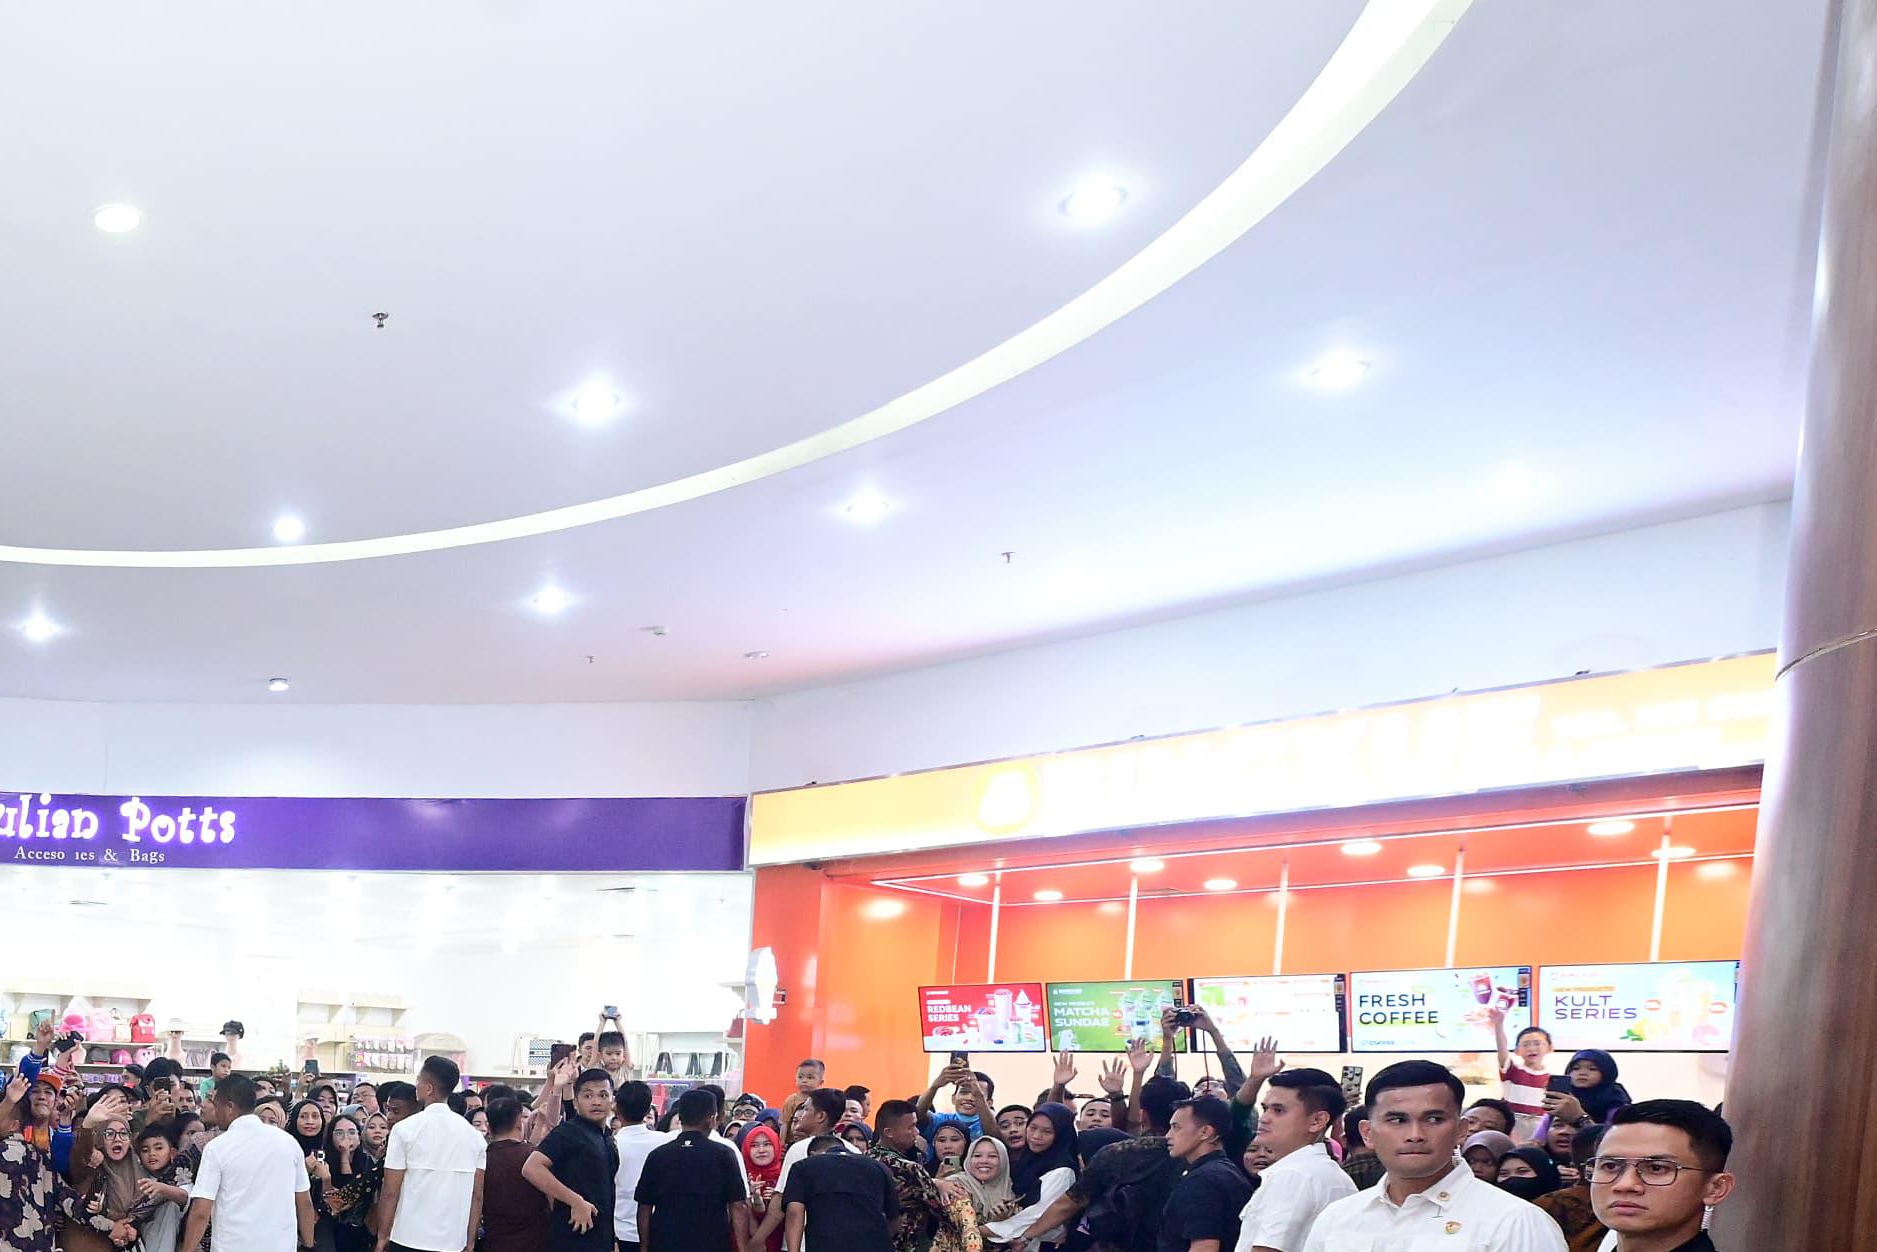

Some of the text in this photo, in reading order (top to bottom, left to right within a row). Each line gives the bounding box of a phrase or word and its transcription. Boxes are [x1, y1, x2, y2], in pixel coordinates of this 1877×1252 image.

[119, 796, 236, 844] Potts
[104, 848, 118, 861] &
[130, 848, 165, 864] Bags
[1359, 993, 1425, 1007] FRESH
[1555, 995, 1613, 1007] KULT
[927, 1004, 972, 1013] REDBEAN
[1054, 1007, 1109, 1017] MATCHA
[1555, 1008, 1637, 1020] SERIES
[928, 1013, 959, 1022] SERIES
[1055, 1017, 1110, 1027] SUNDAE
[1359, 1011, 1439, 1025] COFFEE
